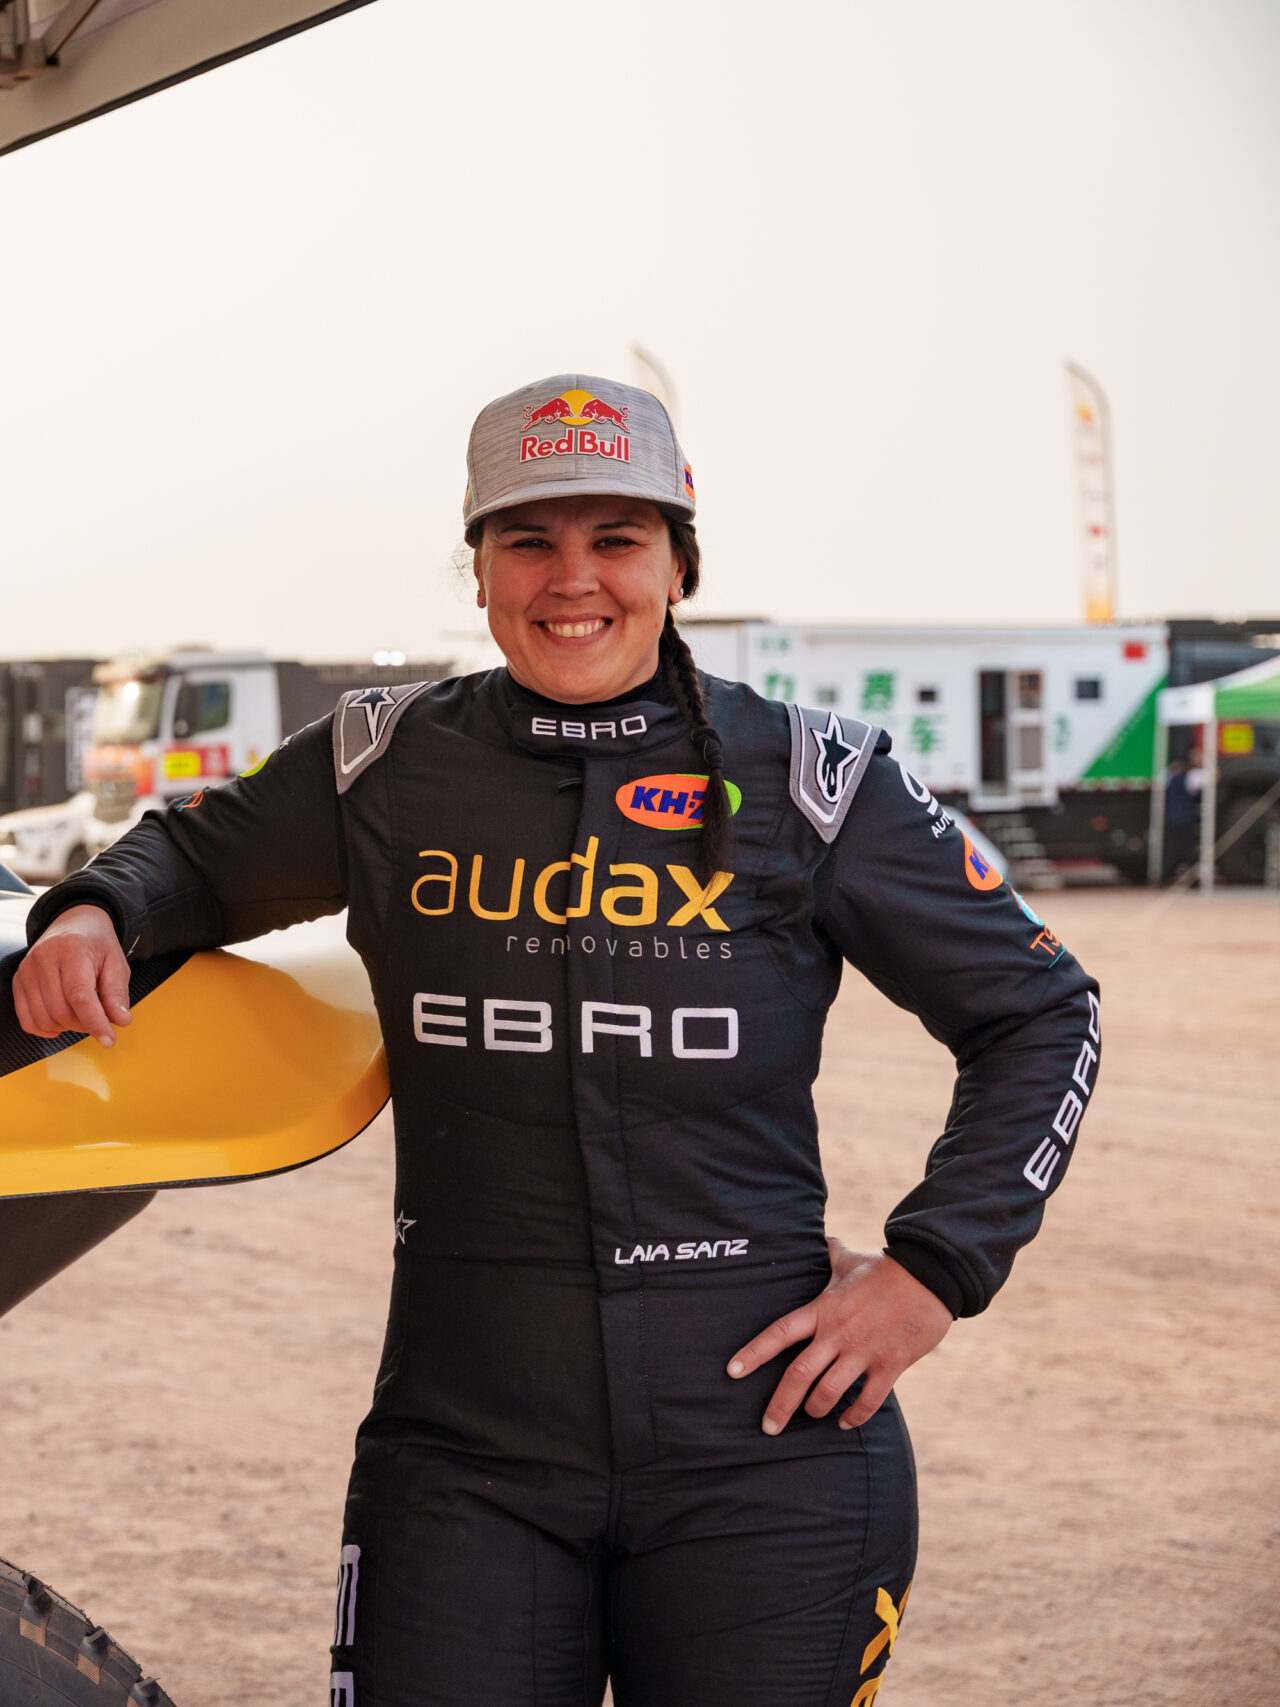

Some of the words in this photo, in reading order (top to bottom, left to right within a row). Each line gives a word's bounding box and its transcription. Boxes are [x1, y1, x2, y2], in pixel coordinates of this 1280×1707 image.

[520, 428, 575, 462] Red
[577, 429, 631, 463] Bull
[531, 715, 648, 740] EBRO
[411, 836, 735, 932] audax
[507, 935, 733, 960] renovables
[413, 992, 739, 1059] EBRO
[1023, 990, 1100, 1191] EBRO
[614, 1244, 670, 1264] LAIA
